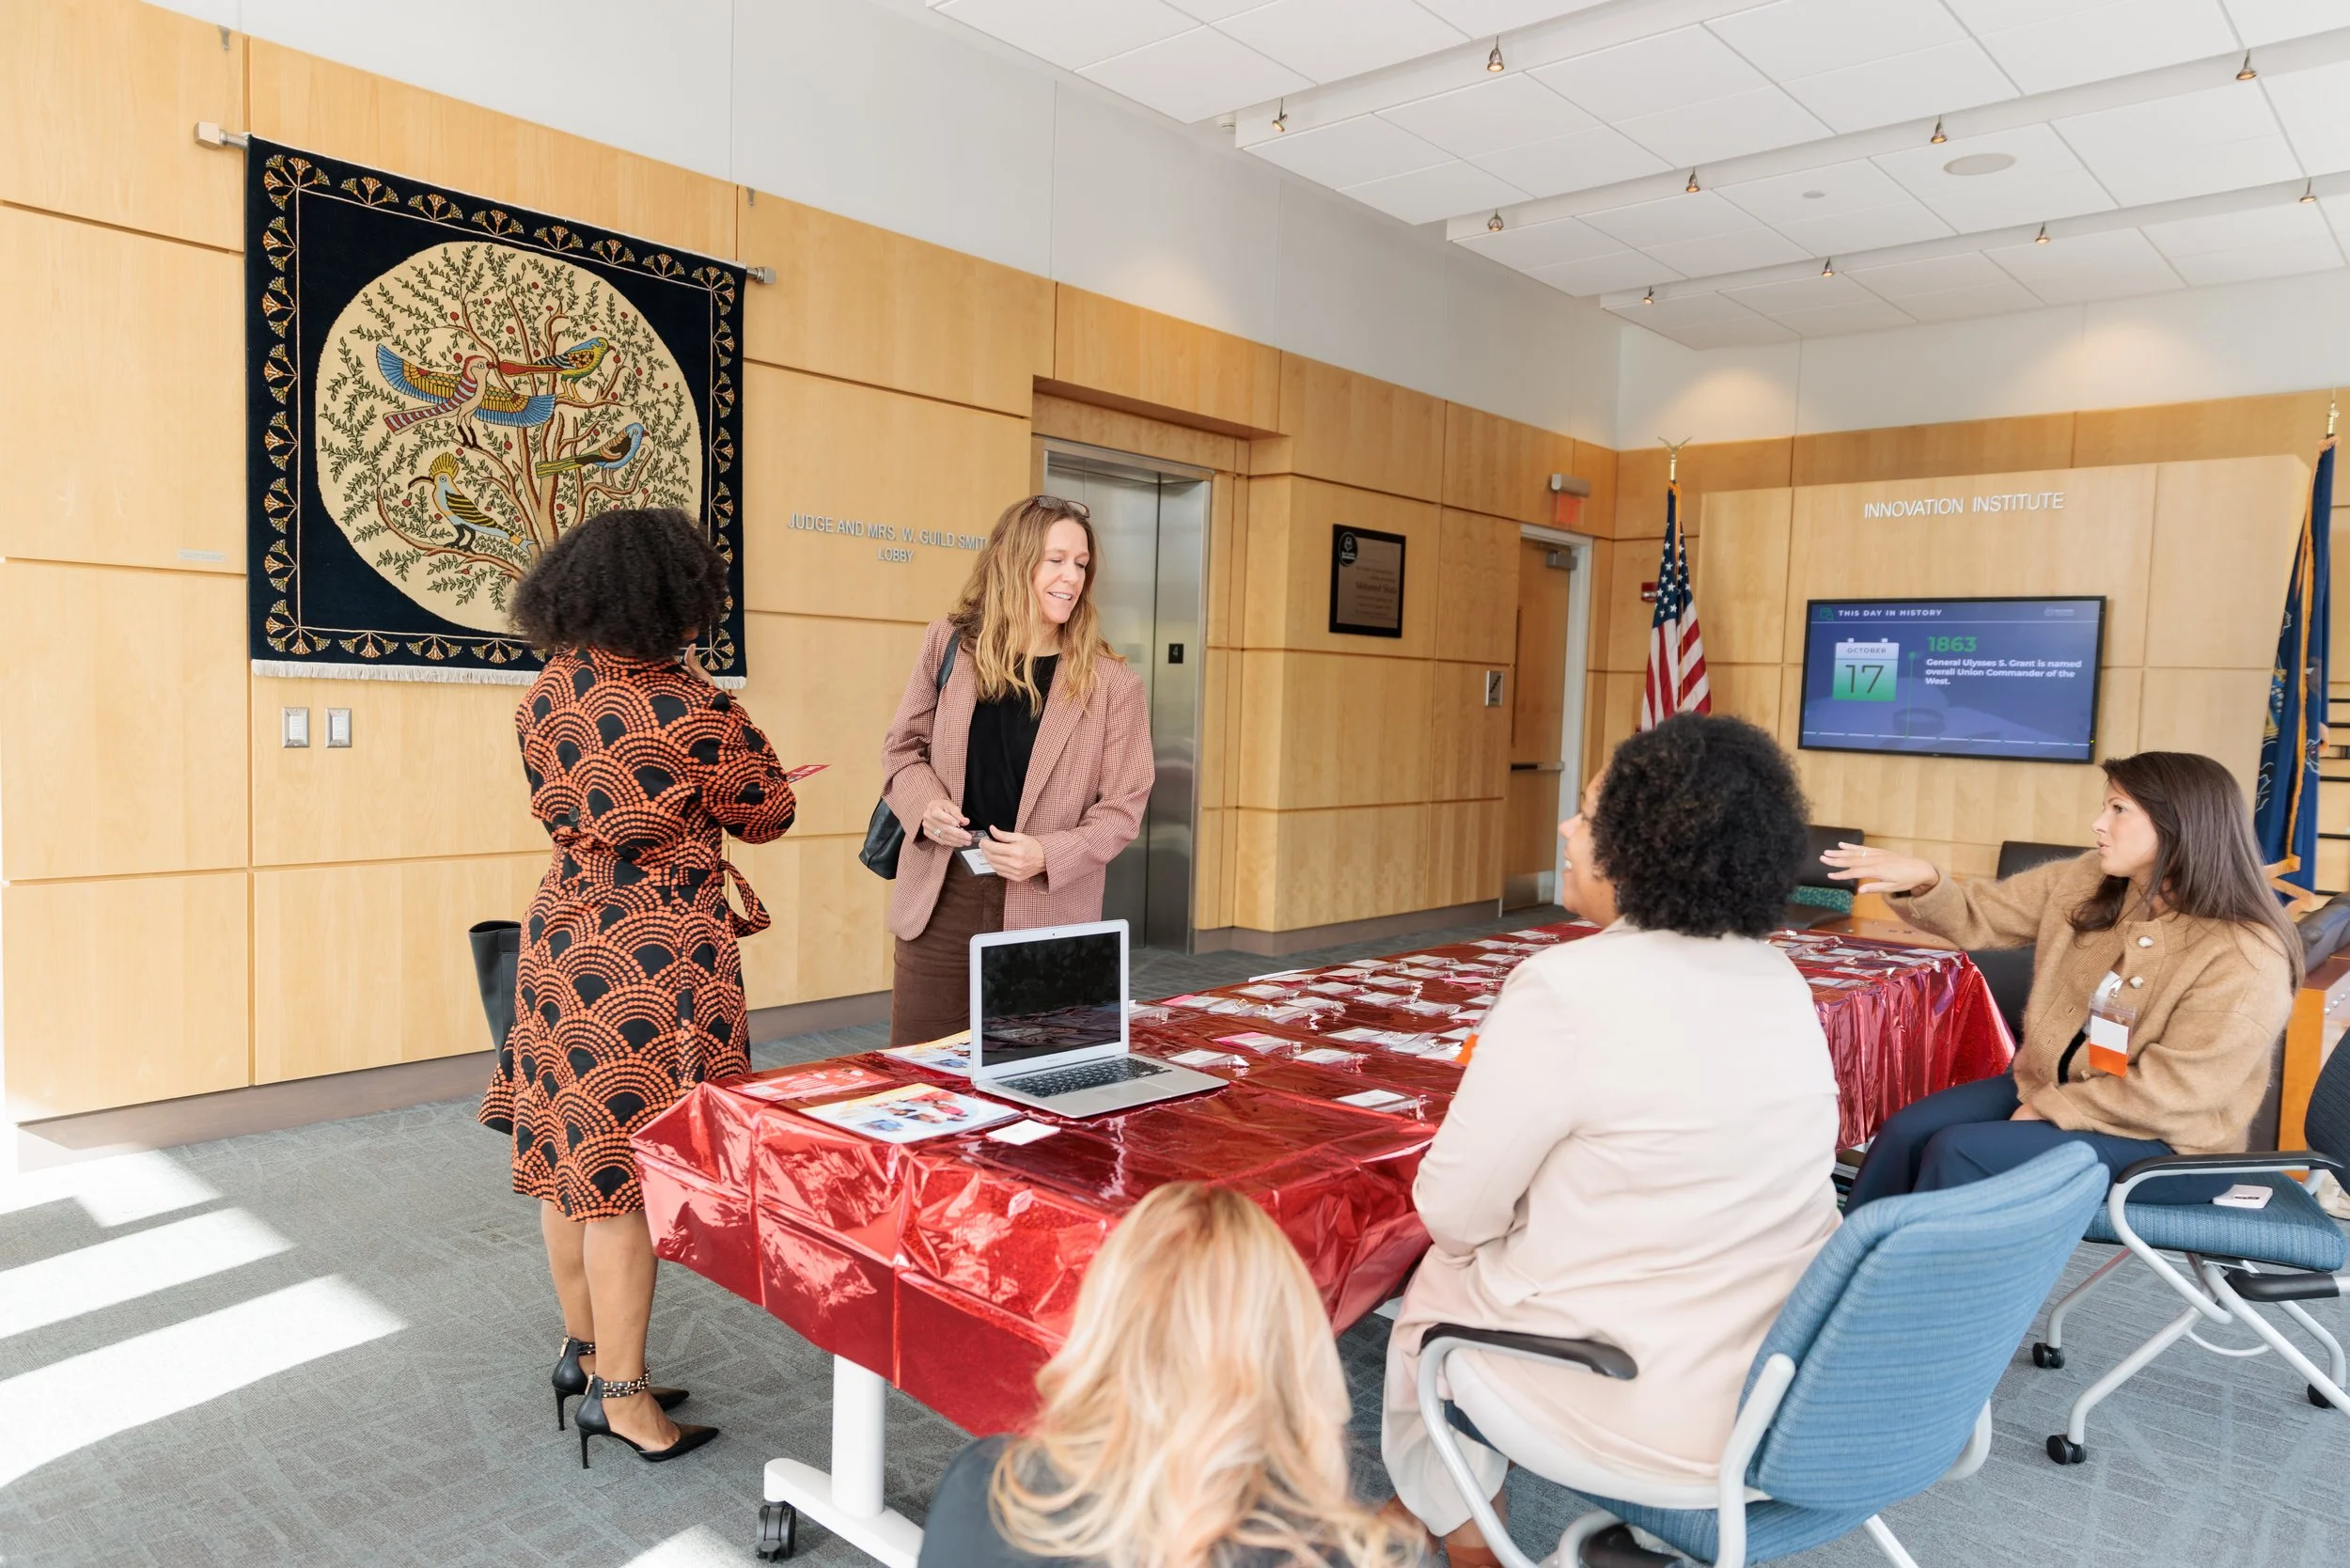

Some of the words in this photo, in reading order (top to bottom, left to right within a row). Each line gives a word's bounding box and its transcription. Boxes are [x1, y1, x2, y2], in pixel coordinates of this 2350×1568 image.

[1865, 499, 1964, 518] INNOVATION
[1973, 493, 2065, 511] INSTITUTE
[788, 512, 834, 533] JUDGE
[837, 520, 864, 536] AND
[867, 523, 899, 541] MRS.
[901, 528, 916, 543] W.
[918, 529, 956, 547] GUILD
[877, 547, 914, 562] LOBBY
[1928, 636, 1976, 651] 1863
[1963, 659, 1998, 668] Ulysses
[1998, 659, 2008, 667] S.
[2009, 659, 2036, 668] Grant
[2038, 659, 2046, 668] is
[2047, 660, 2083, 669] named
[1845, 665, 1885, 694] 17
[1925, 677, 1951, 685] West.
[1957, 668, 1984, 677] Union
[1986, 668, 2044, 678] Commander
[2046, 669, 2058, 678] of
[2059, 669, 2076, 679] the
